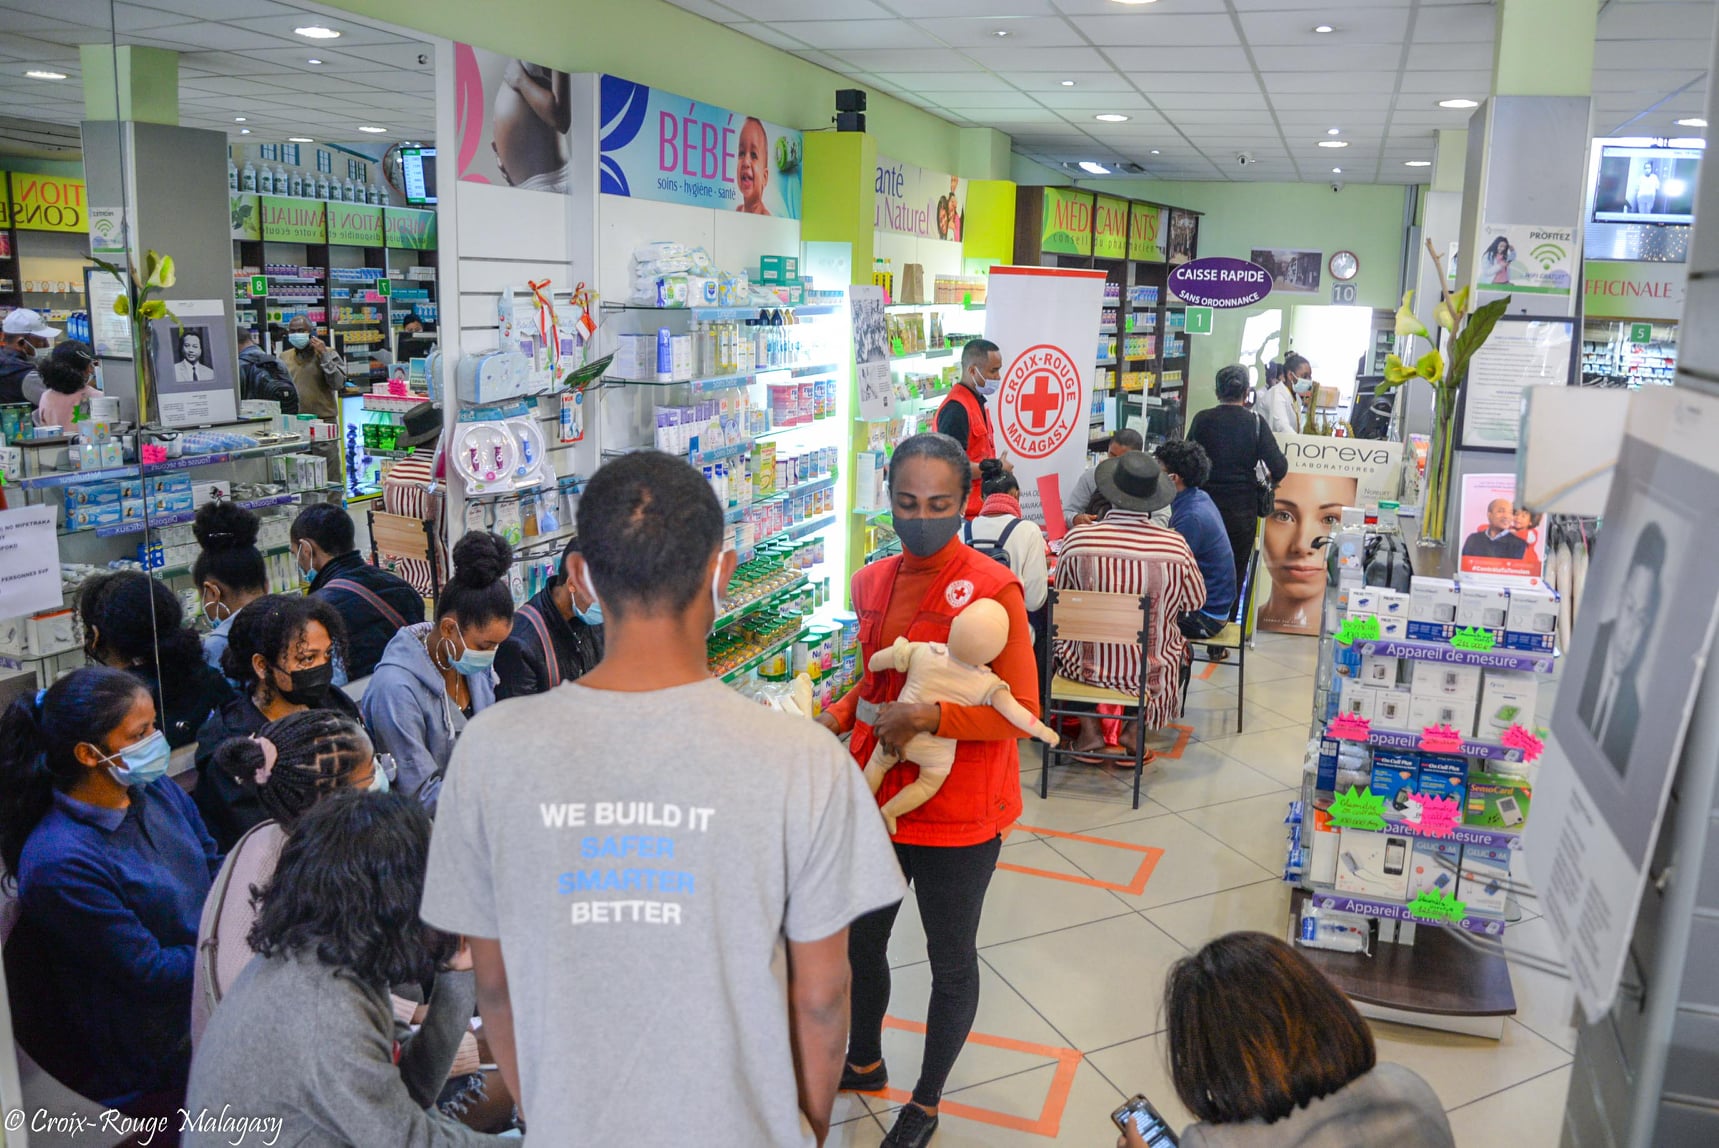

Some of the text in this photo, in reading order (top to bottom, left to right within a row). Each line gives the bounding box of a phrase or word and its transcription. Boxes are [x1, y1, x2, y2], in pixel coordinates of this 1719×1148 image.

[659, 102, 736, 183] BÉBÉ
[657, 176, 678, 191] soins
[684, 179, 713, 200] hygiène
[718, 185, 736, 200] santé
[875, 164, 904, 198] anté
[884, 197, 930, 235] Naturel
[1053, 193, 1156, 241] MÉDICAMNTS
[1529, 231, 1571, 241] PROFITEZ
[1176, 268, 1265, 282] CAISSE RAPIDE
[1178, 289, 1260, 308] SANS ORDONNANCE
[1333, 286, 1354, 301] 10
[1584, 279, 1673, 298] FFICINALE
[1196, 313, 1202, 328] 1
[1637, 328, 1645, 339] 5
[1004, 353, 1076, 405] CROIX-ROUGE
[1007, 419, 1069, 453] MALAGASY
[1284, 441, 1389, 465] noreva
[1296, 462, 1375, 473] LABORATOIRES
[1386, 645, 1443, 663] Appareil
[1447, 648, 1464, 662] de
[1466, 653, 1518, 668] mesure
[1369, 733, 1416, 748] ppareil
[1460, 744, 1489, 757] sure
[540, 801, 716, 833] WE BUILD IT
[580, 835, 675, 860] SAFER
[557, 868, 696, 896] SMARTER
[571, 900, 682, 925] BETTER
[1346, 900, 1399, 918] Appareil
